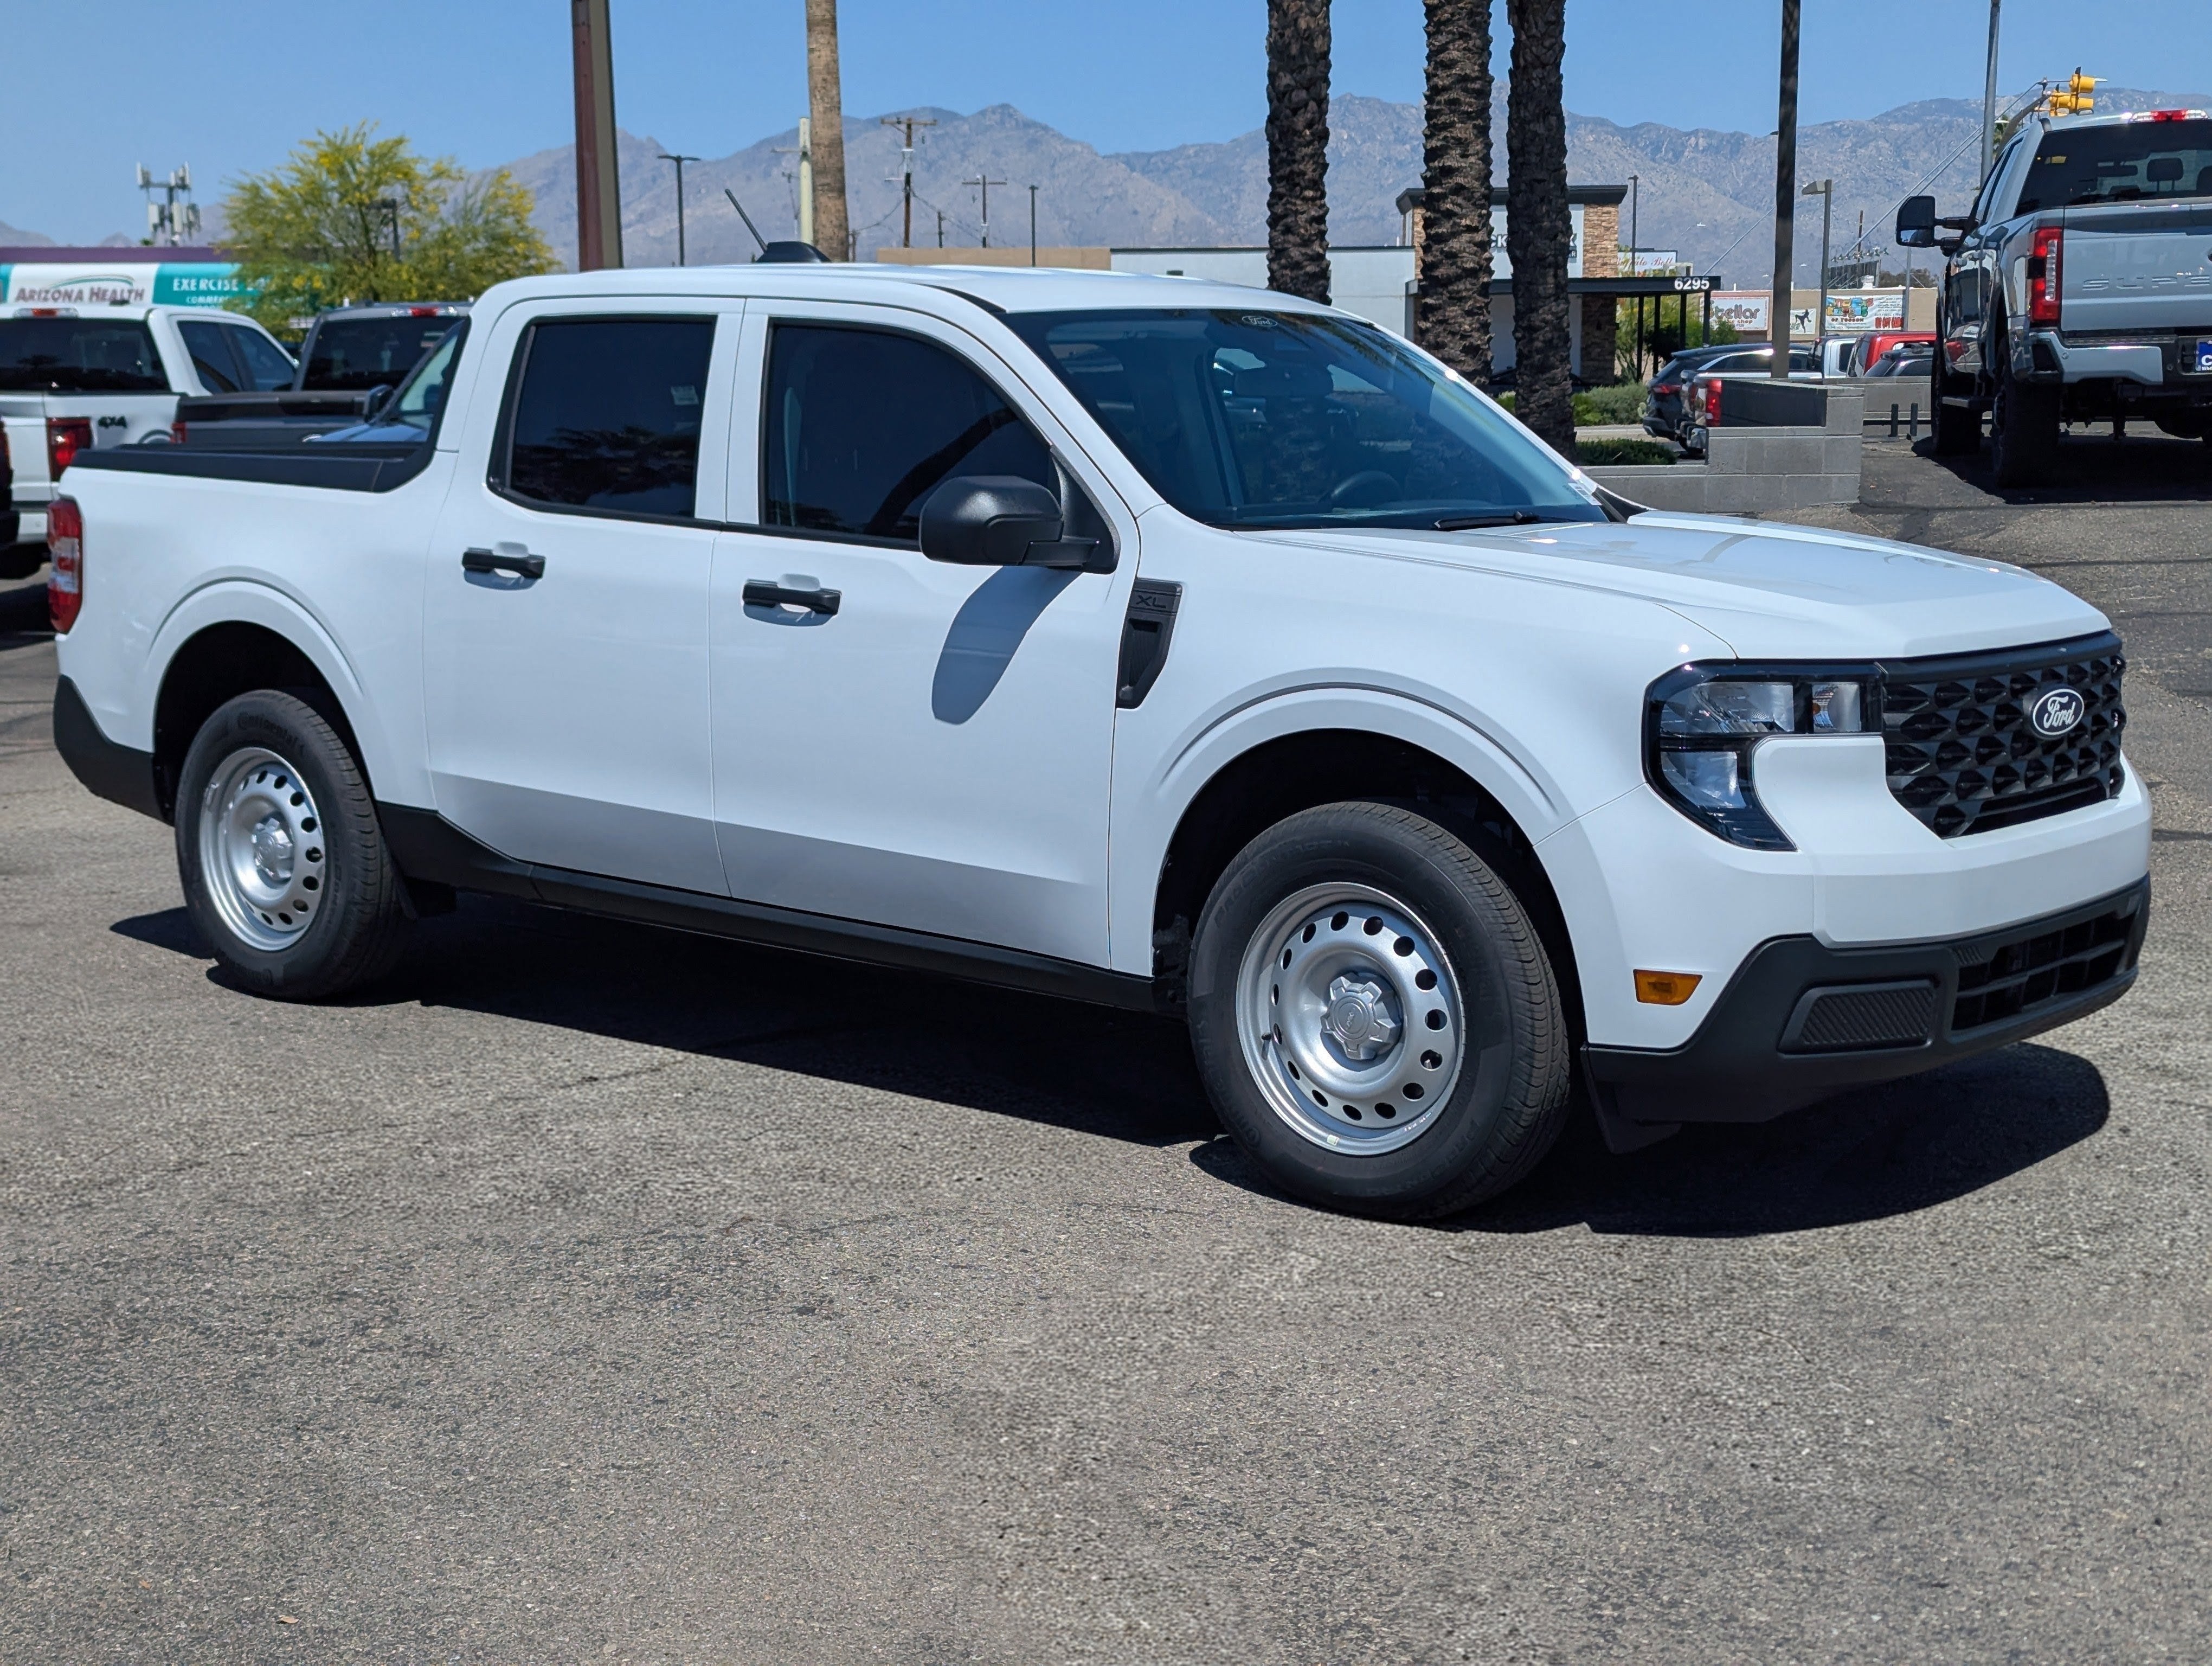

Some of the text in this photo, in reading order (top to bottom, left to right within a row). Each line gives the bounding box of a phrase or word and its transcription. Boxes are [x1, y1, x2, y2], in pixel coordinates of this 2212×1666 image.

[172, 277, 239, 291] EXERCISE
[1674, 277, 1710, 290] 6295
[15, 287, 145, 302] ARIZONA HEALTH
[1135, 595, 1166, 608] XL
[2043, 695, 2076, 729] Ford
